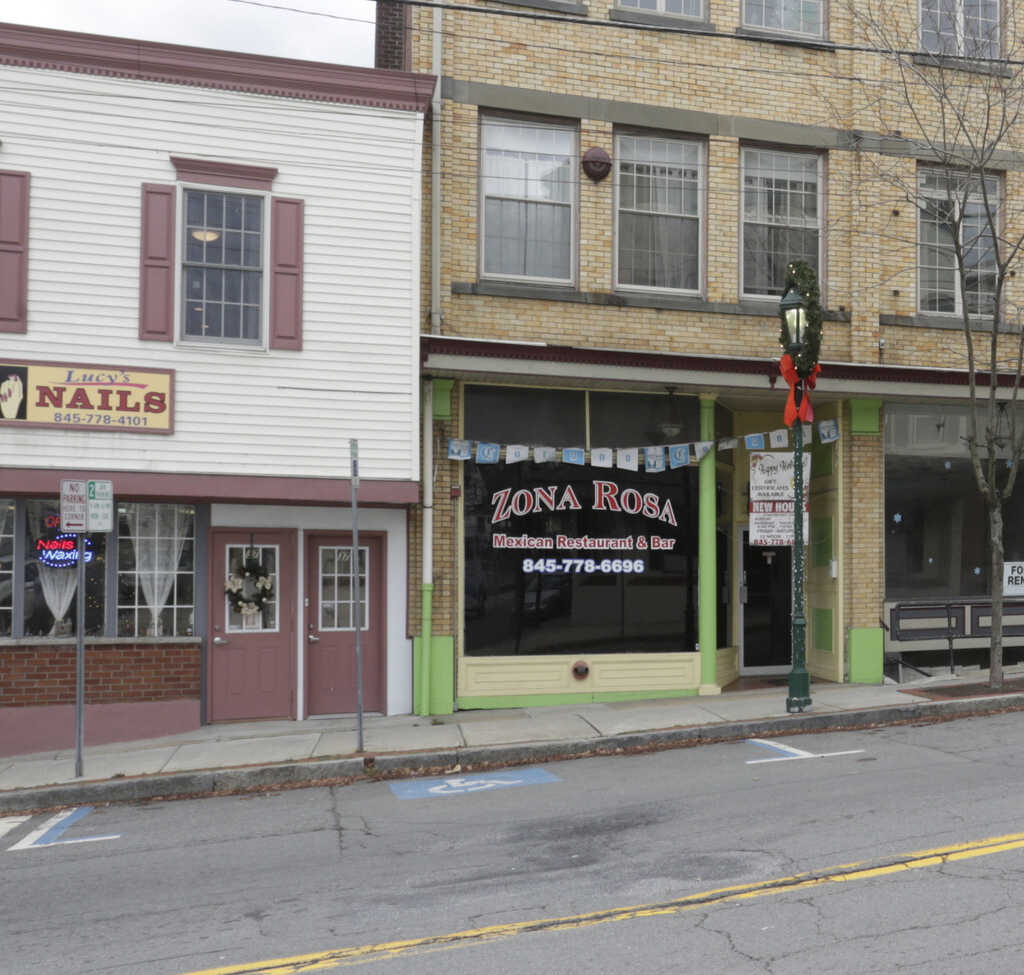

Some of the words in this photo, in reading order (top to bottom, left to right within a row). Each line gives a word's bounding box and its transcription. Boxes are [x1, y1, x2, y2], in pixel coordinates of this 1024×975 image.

[64, 369, 131, 386] Lucy's
[35, 385, 167, 414] NAILS
[53, 412, 148, 426] 845-778-4101
[69, 482, 80, 493] NO
[89, 483, 95, 498] 2
[63, 494, 87, 504] PARKING
[491, 484, 582, 524] ZONA
[592, 480, 678, 527] ROSA
[753, 501, 773, 513] NEW
[775, 501, 807, 513] HOUS
[64, 512, 85, 521] CORNER
[37, 539, 75, 550] Nails
[492, 532, 554, 549] Mexican
[556, 534, 634, 550] Restaurant
[636, 536, 648, 550] &
[650, 535, 676, 550] Bar
[522, 558, 645, 574] 845-778-6696
